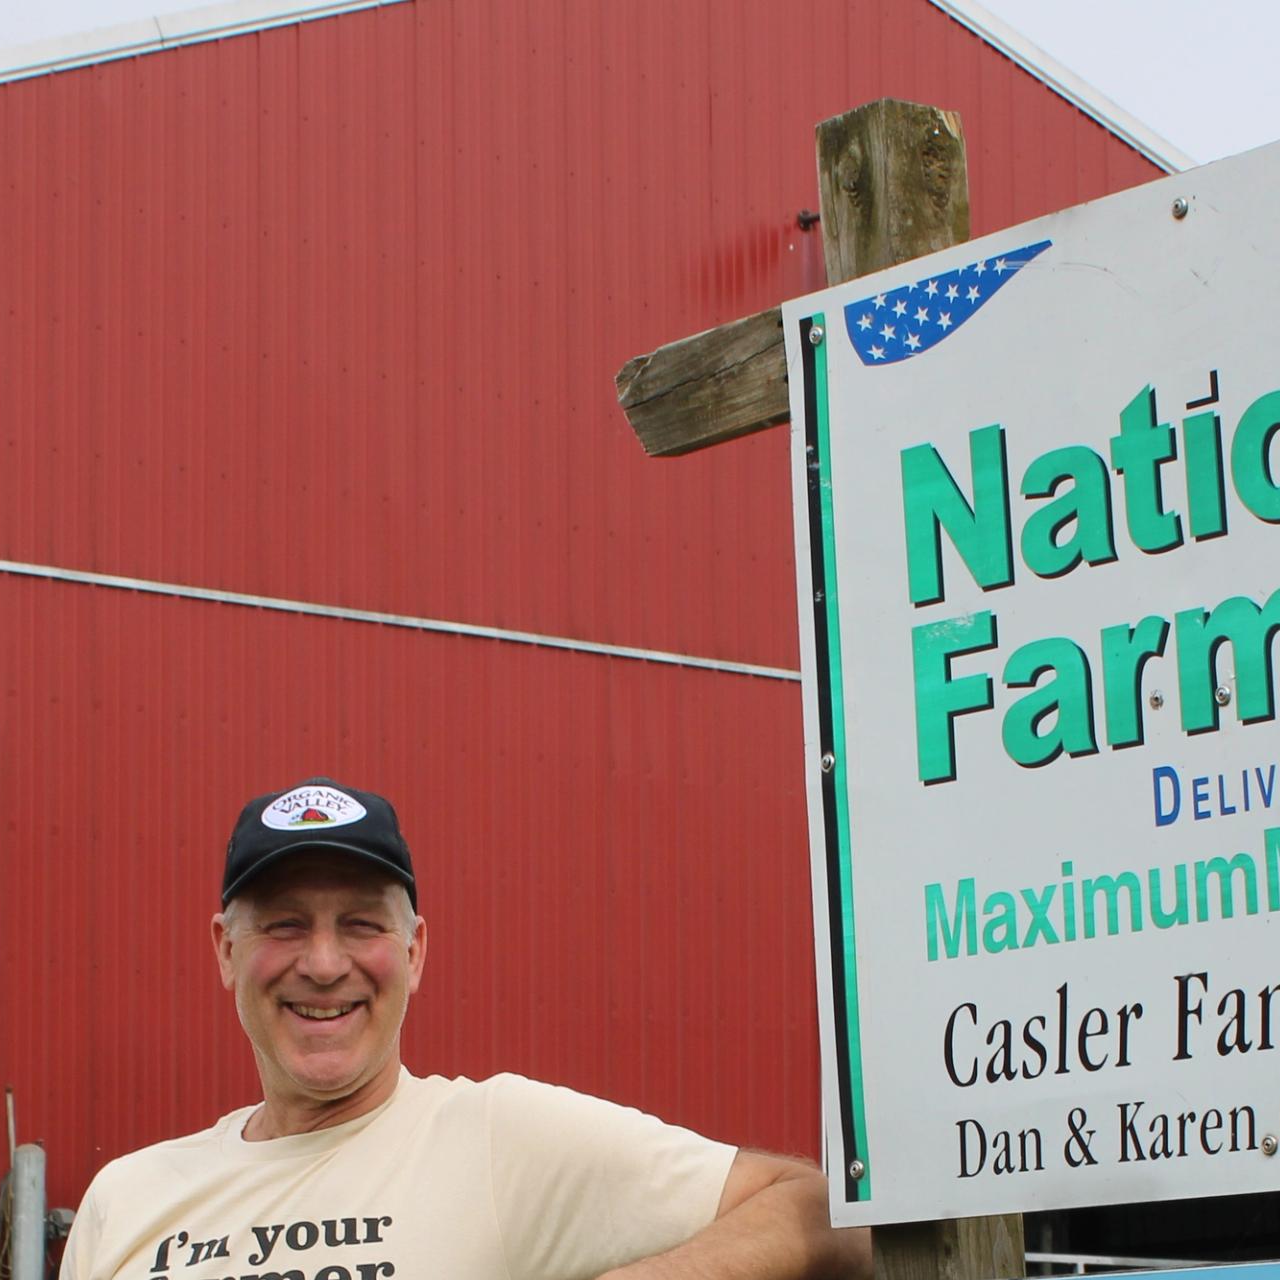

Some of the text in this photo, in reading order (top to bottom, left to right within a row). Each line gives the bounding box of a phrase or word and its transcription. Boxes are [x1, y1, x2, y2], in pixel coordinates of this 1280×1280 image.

[273, 790, 356, 810] ORGANIC
[280, 798, 345, 813] VALLEY
[943, 982, 1143, 1087] Casler
[956, 1120, 1045, 1180] Dan
[1063, 1107, 1098, 1167] &
[1117, 1101, 1259, 1163] Karen
[150, 1215, 393, 1273] I'm your
